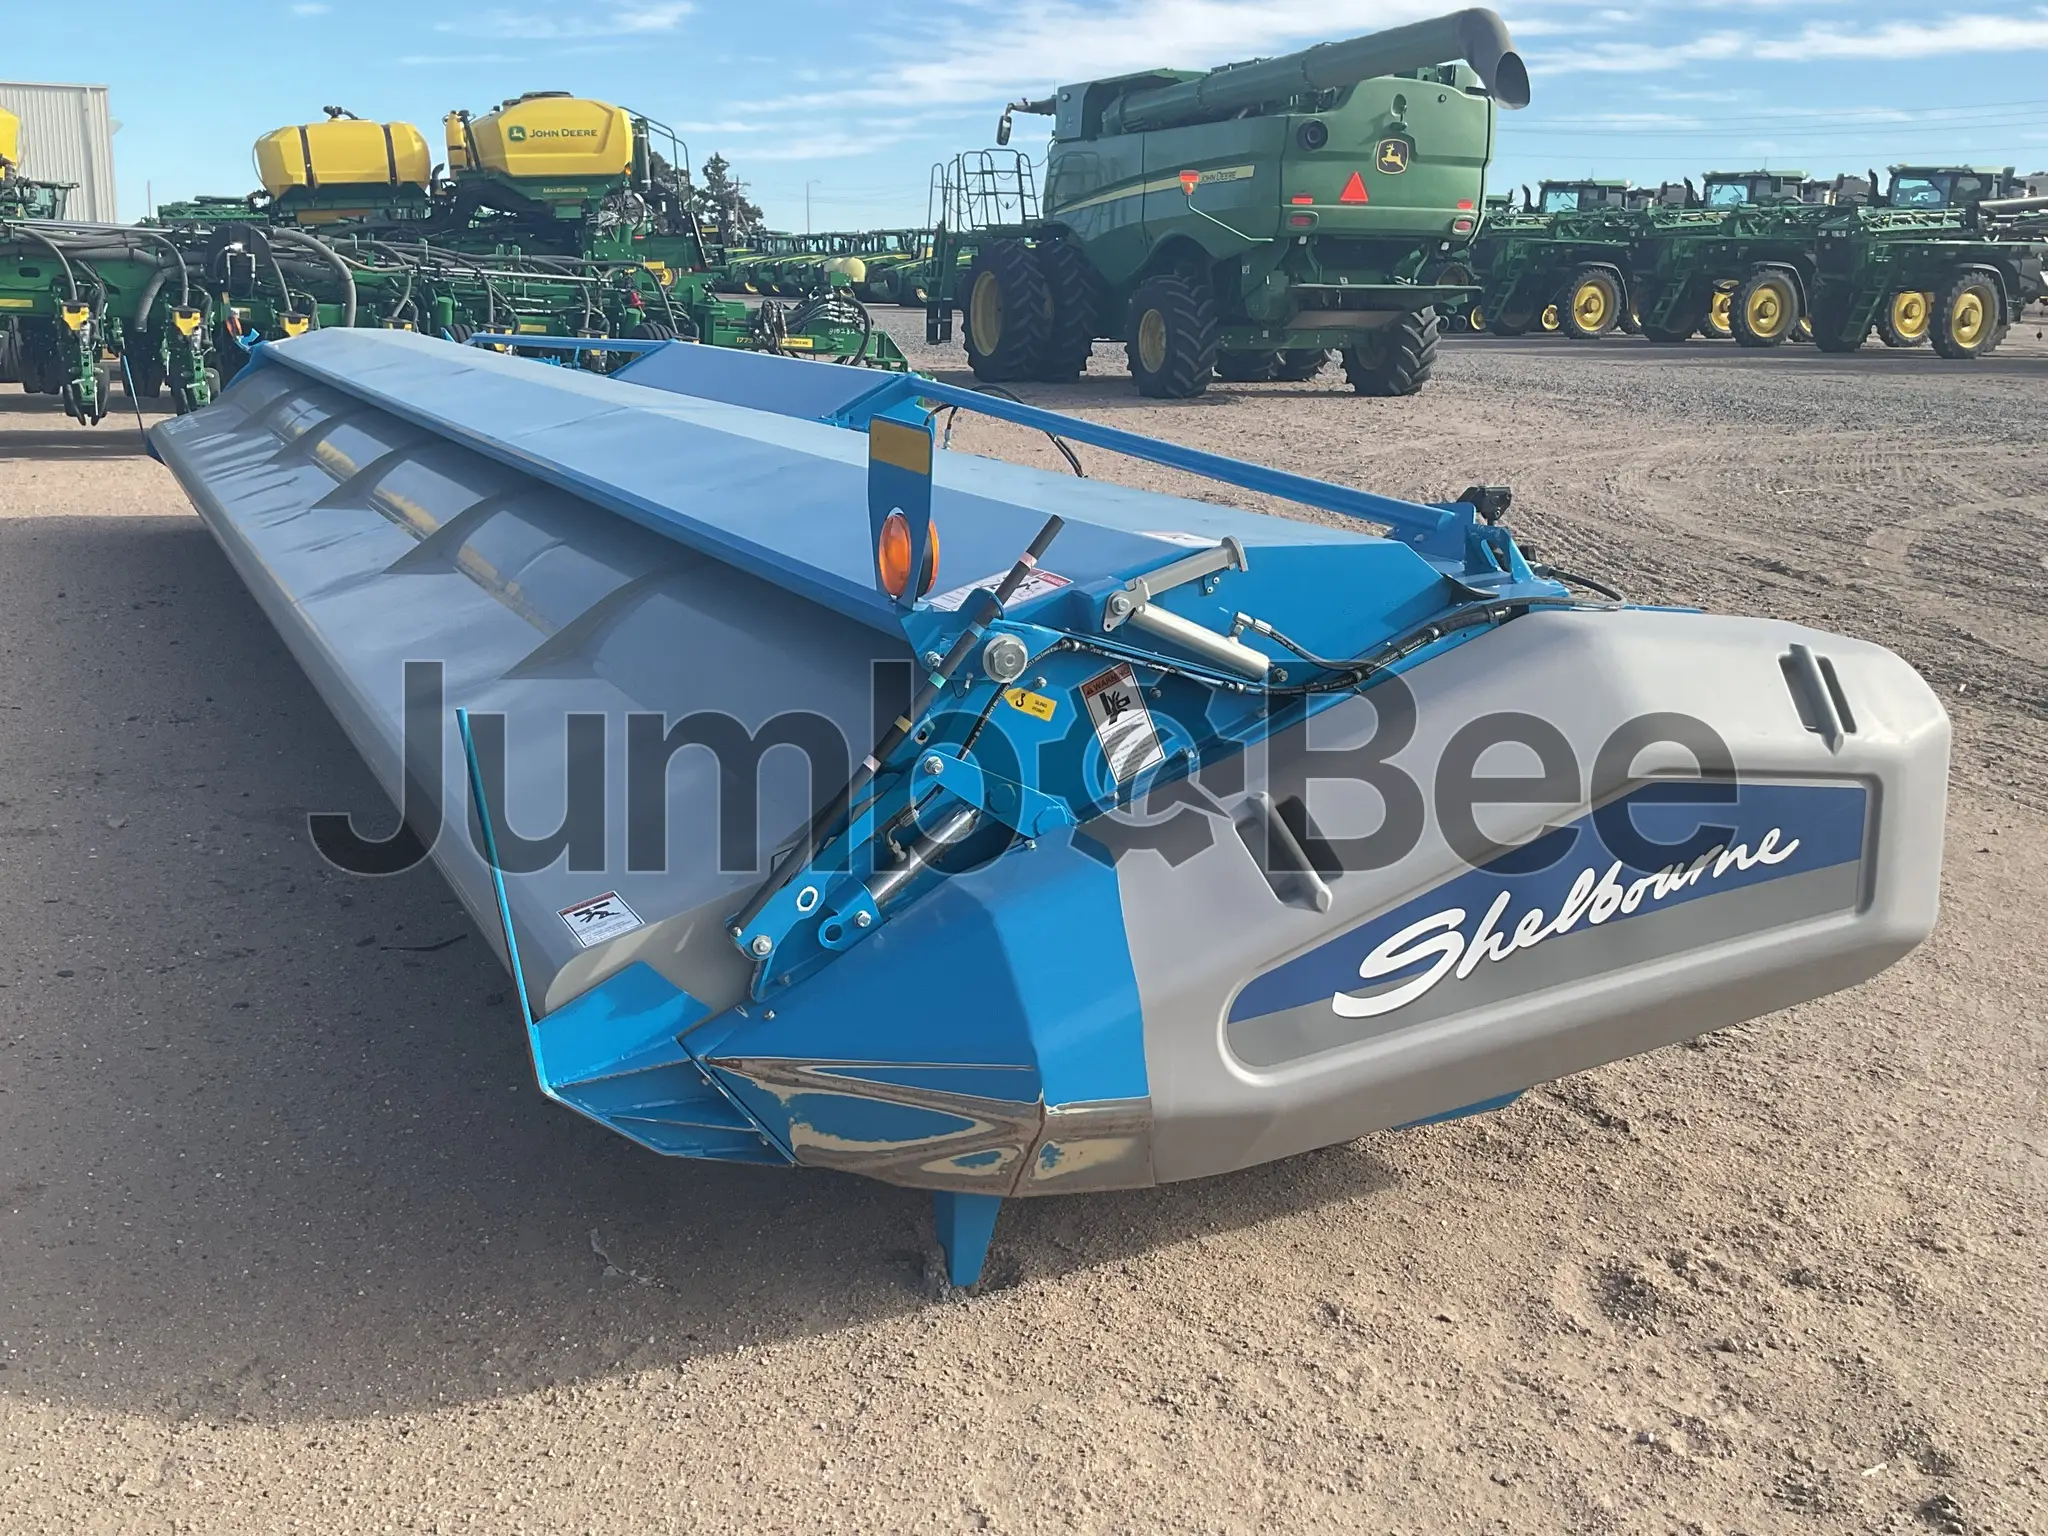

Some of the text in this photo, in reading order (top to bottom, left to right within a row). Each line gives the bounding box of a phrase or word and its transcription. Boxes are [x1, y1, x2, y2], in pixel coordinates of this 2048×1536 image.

[529, 128, 598, 138] JOHN DEERE
[1217, 171, 1237, 181] DEERE
[1093, 668, 1131, 691] WARNING
[1332, 828, 1801, 1019] Shelbourne
